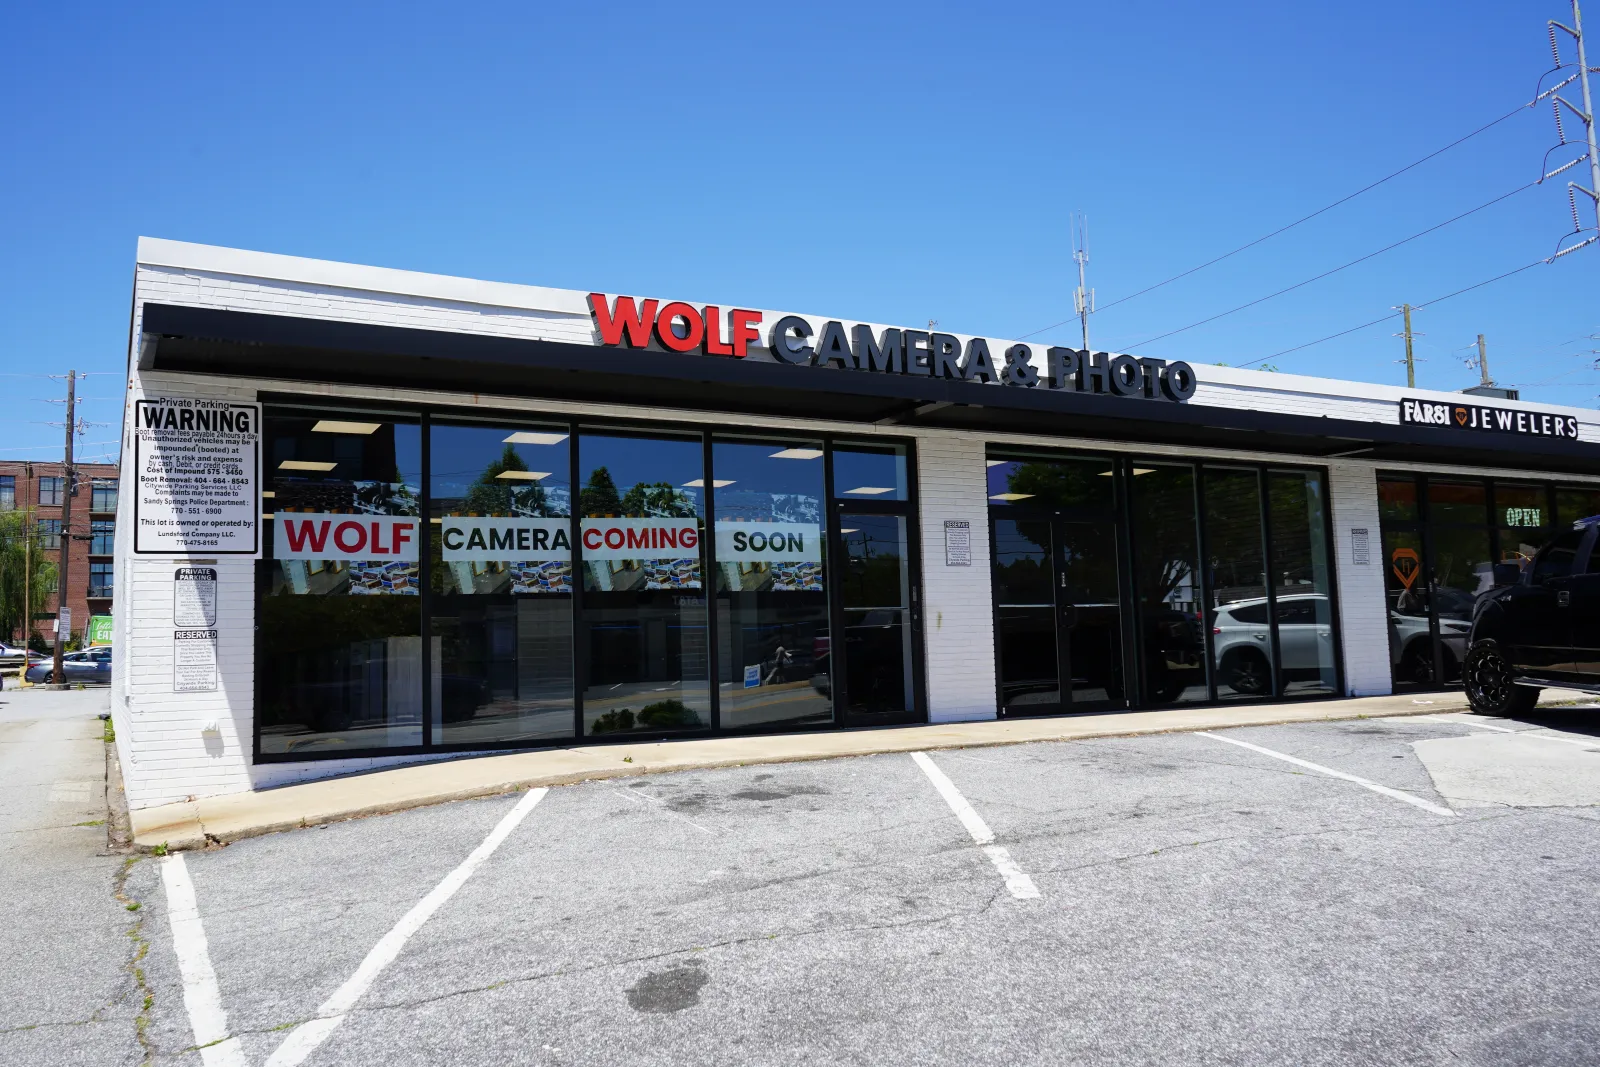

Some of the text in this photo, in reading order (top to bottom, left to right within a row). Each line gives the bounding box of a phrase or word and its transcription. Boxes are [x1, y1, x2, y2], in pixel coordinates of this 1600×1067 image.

[590, 292, 1196, 401] WOLF CAMERA & PHOTO
[160, 398, 230, 411] Private Parking
[143, 407, 250, 433] WARNING
[1404, 400, 1576, 438] FARSI JEWELERS
[142, 435, 192, 443] Unauthorized
[192, 430, 215, 439] payable
[198, 446, 229, 454] (booted)
[1506, 508, 1540, 527] OPEN
[284, 520, 414, 554] WOLF
[443, 527, 571, 550] CAMERA
[583, 528, 697, 550] COMING
[733, 531, 804, 552] SOON
